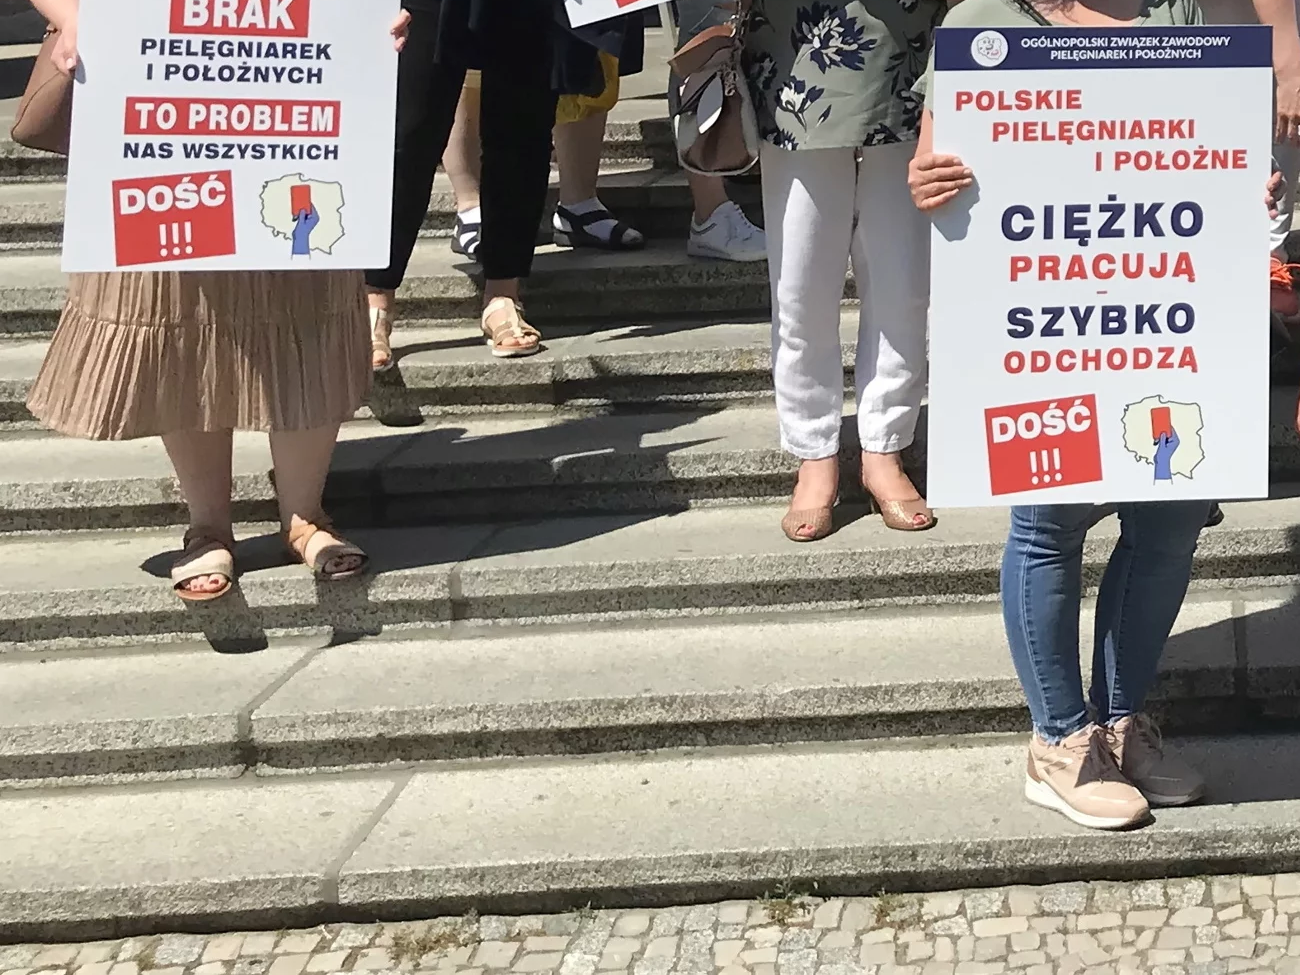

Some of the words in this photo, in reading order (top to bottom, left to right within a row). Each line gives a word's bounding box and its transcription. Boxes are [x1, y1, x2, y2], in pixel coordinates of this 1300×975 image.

[141, 38, 332, 61] PIELĘGNIAREK
[1021, 36, 1108, 48] OGÓLNOPOLSKI
[1110, 37, 1159, 48] ZWIĄZEK
[1162, 36, 1231, 47] ZAWODOWY
[1050, 50, 1127, 61] PIELĘGNIAREK
[1136, 48, 1201, 60] POŁOŻNYCH
[146, 64, 153, 81] I
[164, 62, 323, 84] POŁOŻNYCH
[956, 90, 1082, 111] POLSKIE
[135, 102, 177, 130] TO
[188, 103, 333, 132] PROBLEM
[992, 119, 1195, 145] PIELĘGNIARKI
[123, 142, 173, 159] NAS
[183, 142, 339, 161] WSZYSTKICH
[1095, 152, 1102, 171] I
[1115, 145, 1248, 171] POŁOŻNE
[119, 174, 227, 215] DOŚĆ
[1001, 194, 1203, 246] CIĘŻKO
[158, 221, 193, 257] !!!
[1010, 252, 1196, 283] PRACUJĄ
[1006, 303, 1195, 339] SZYBKO
[1004, 346, 1198, 374] ODCHODZĄ
[991, 399, 1092, 444] DOŚĆ
[1030, 447, 1062, 485] !!!
